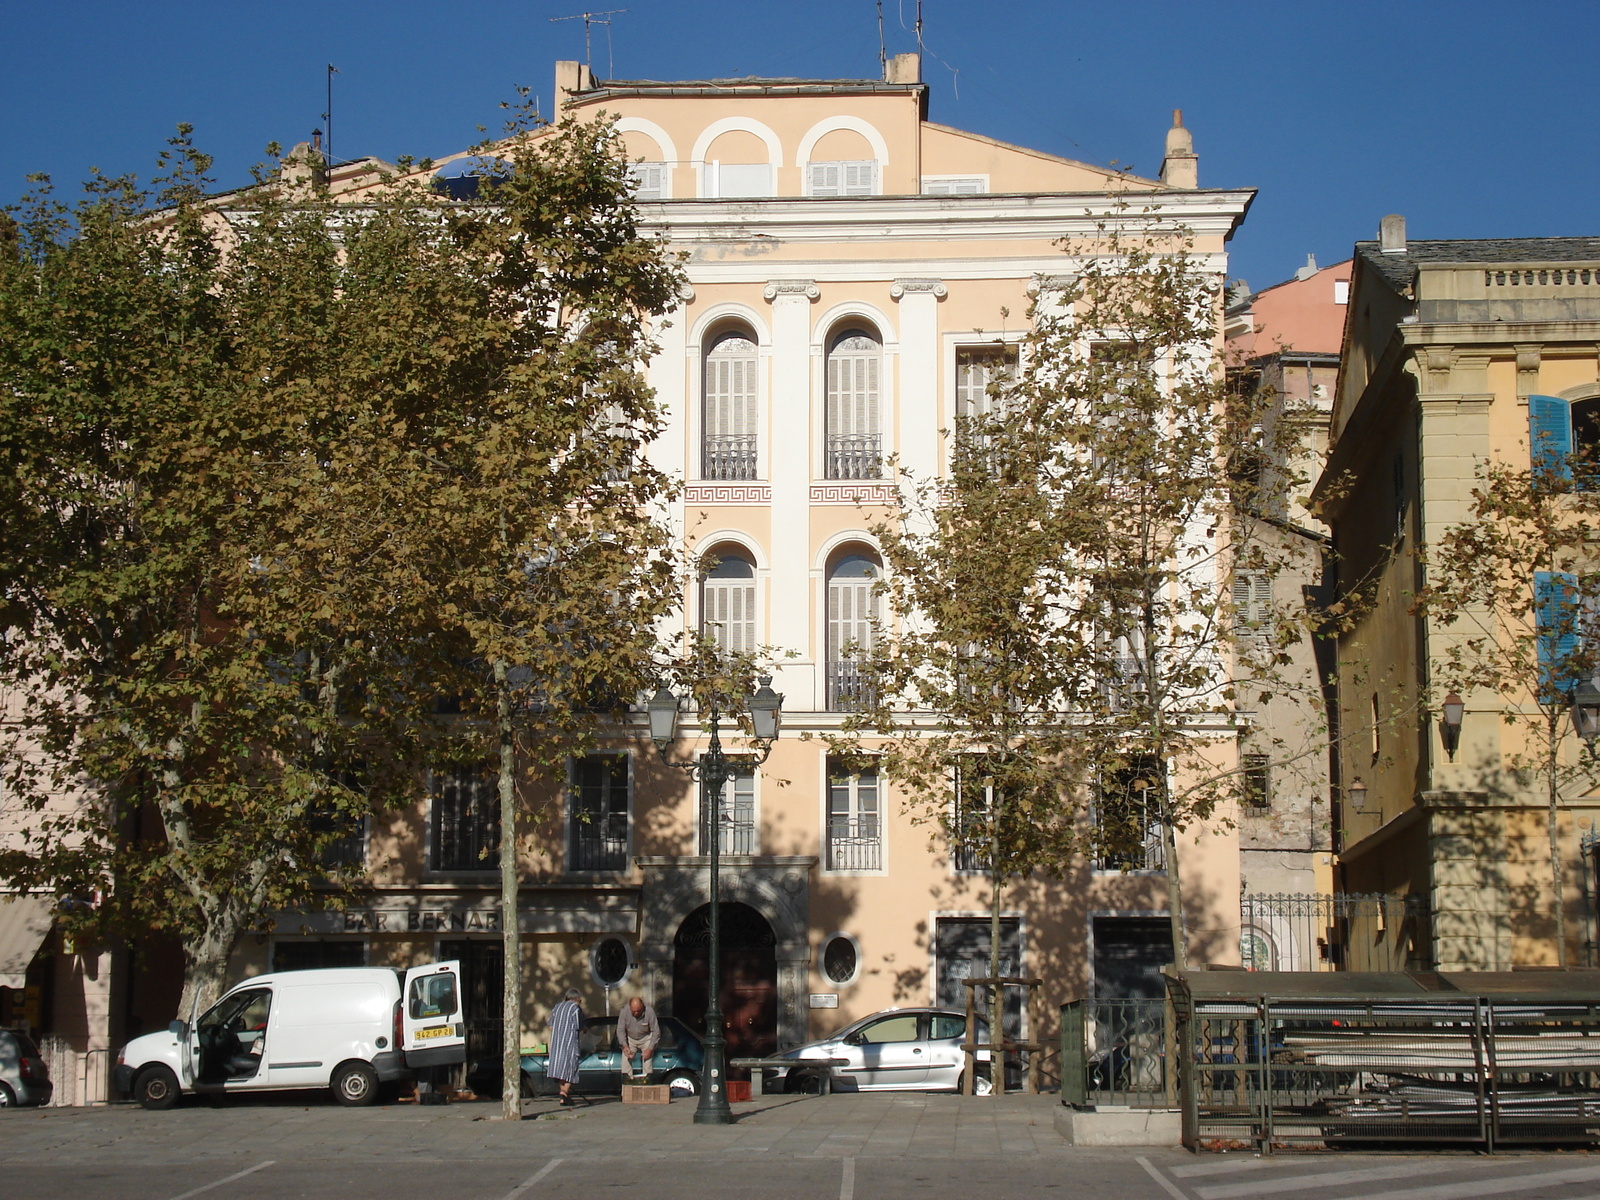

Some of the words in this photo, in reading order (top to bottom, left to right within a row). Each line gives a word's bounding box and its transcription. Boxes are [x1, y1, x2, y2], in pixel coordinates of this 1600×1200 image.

[344, 912, 388, 931] BAR
[408, 912, 504, 931] BERNAR
[416, 1031, 430, 1039] 942
